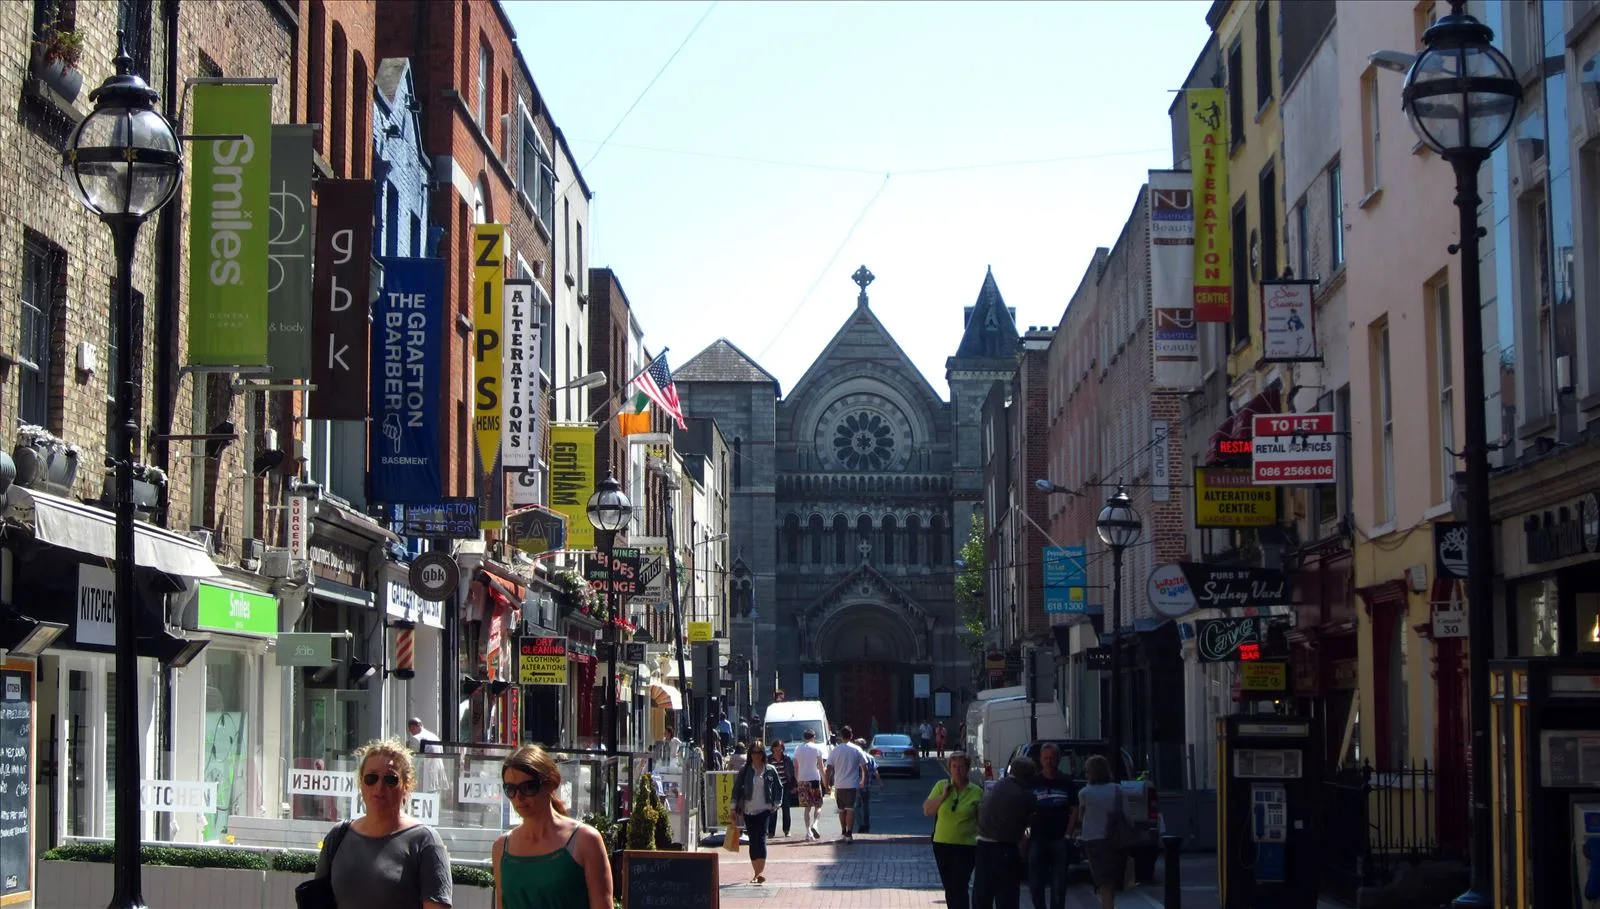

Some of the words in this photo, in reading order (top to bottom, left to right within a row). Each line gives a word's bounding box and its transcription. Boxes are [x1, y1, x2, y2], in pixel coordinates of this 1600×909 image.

[211, 133, 254, 286] Smiles
[1203, 133, 1220, 280] ALTERATION
[388, 292, 426, 309] THE
[1196, 292, 1229, 304] CENTRE
[280, 322, 304, 335] body
[476, 234, 500, 411] ZIPS
[384, 312, 403, 410] BARBER
[406, 312, 426, 428] GRAFTON
[510, 290, 525, 448] ALTERATIONS
[476, 415, 500, 431] HEMS
[1270, 420, 1290, 431] TO
[1294, 418, 1320, 431] LET
[1256, 444, 1286, 454] RETAIL
[381, 456, 429, 465] BASEMENT
[553, 442, 587, 506] GOTHAM
[1260, 467, 1280, 477] 086
[1205, 491, 1272, 501] ALTERATIONS
[1219, 503, 1257, 513] CENTRE
[292, 499, 300, 555] SURGERY
[510, 519, 560, 545] EAT
[612, 549, 638, 558] WINES
[422, 568, 446, 582] gbk
[1200, 581, 1249, 604] Sydney
[1251, 581, 1284, 599] Vard
[230, 591, 250, 619] Smiles
[1443, 625, 1459, 634] 30
[140, 785, 211, 808] KTCHEN
[722, 773, 730, 816] ZIPS
